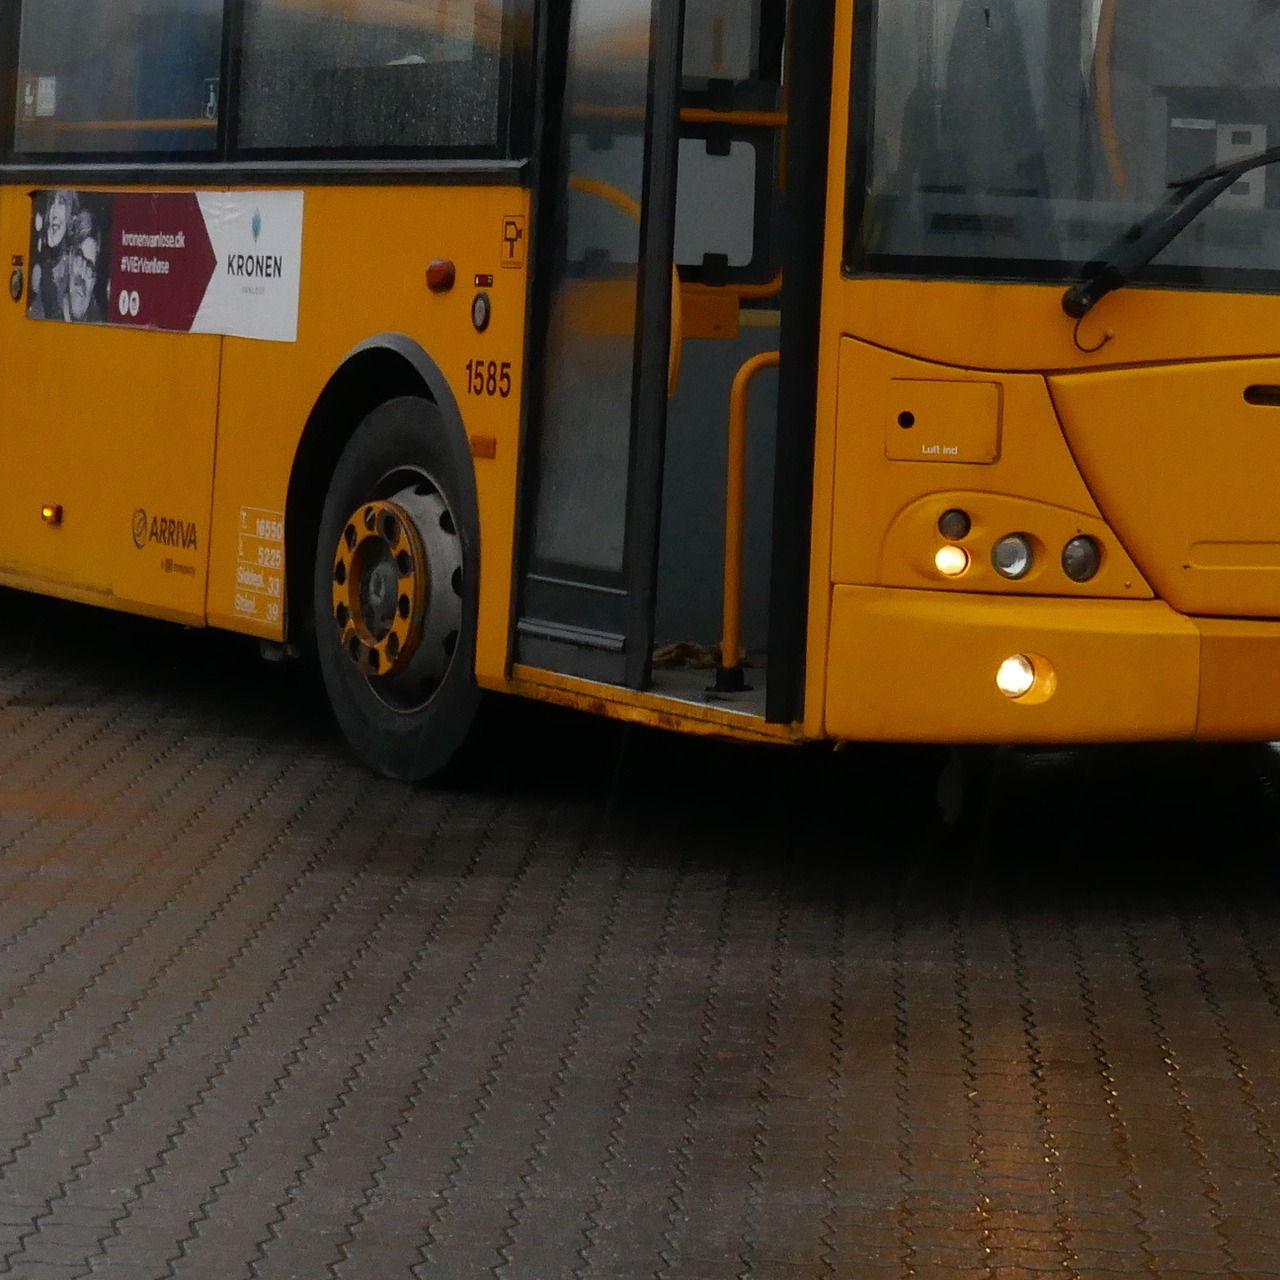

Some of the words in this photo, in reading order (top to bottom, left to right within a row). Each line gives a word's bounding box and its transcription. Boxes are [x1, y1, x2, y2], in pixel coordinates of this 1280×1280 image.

[227, 254, 282, 278] KRONEN
[465, 359, 512, 398] 1585
[148, 516, 198, 551] ARRIVA
